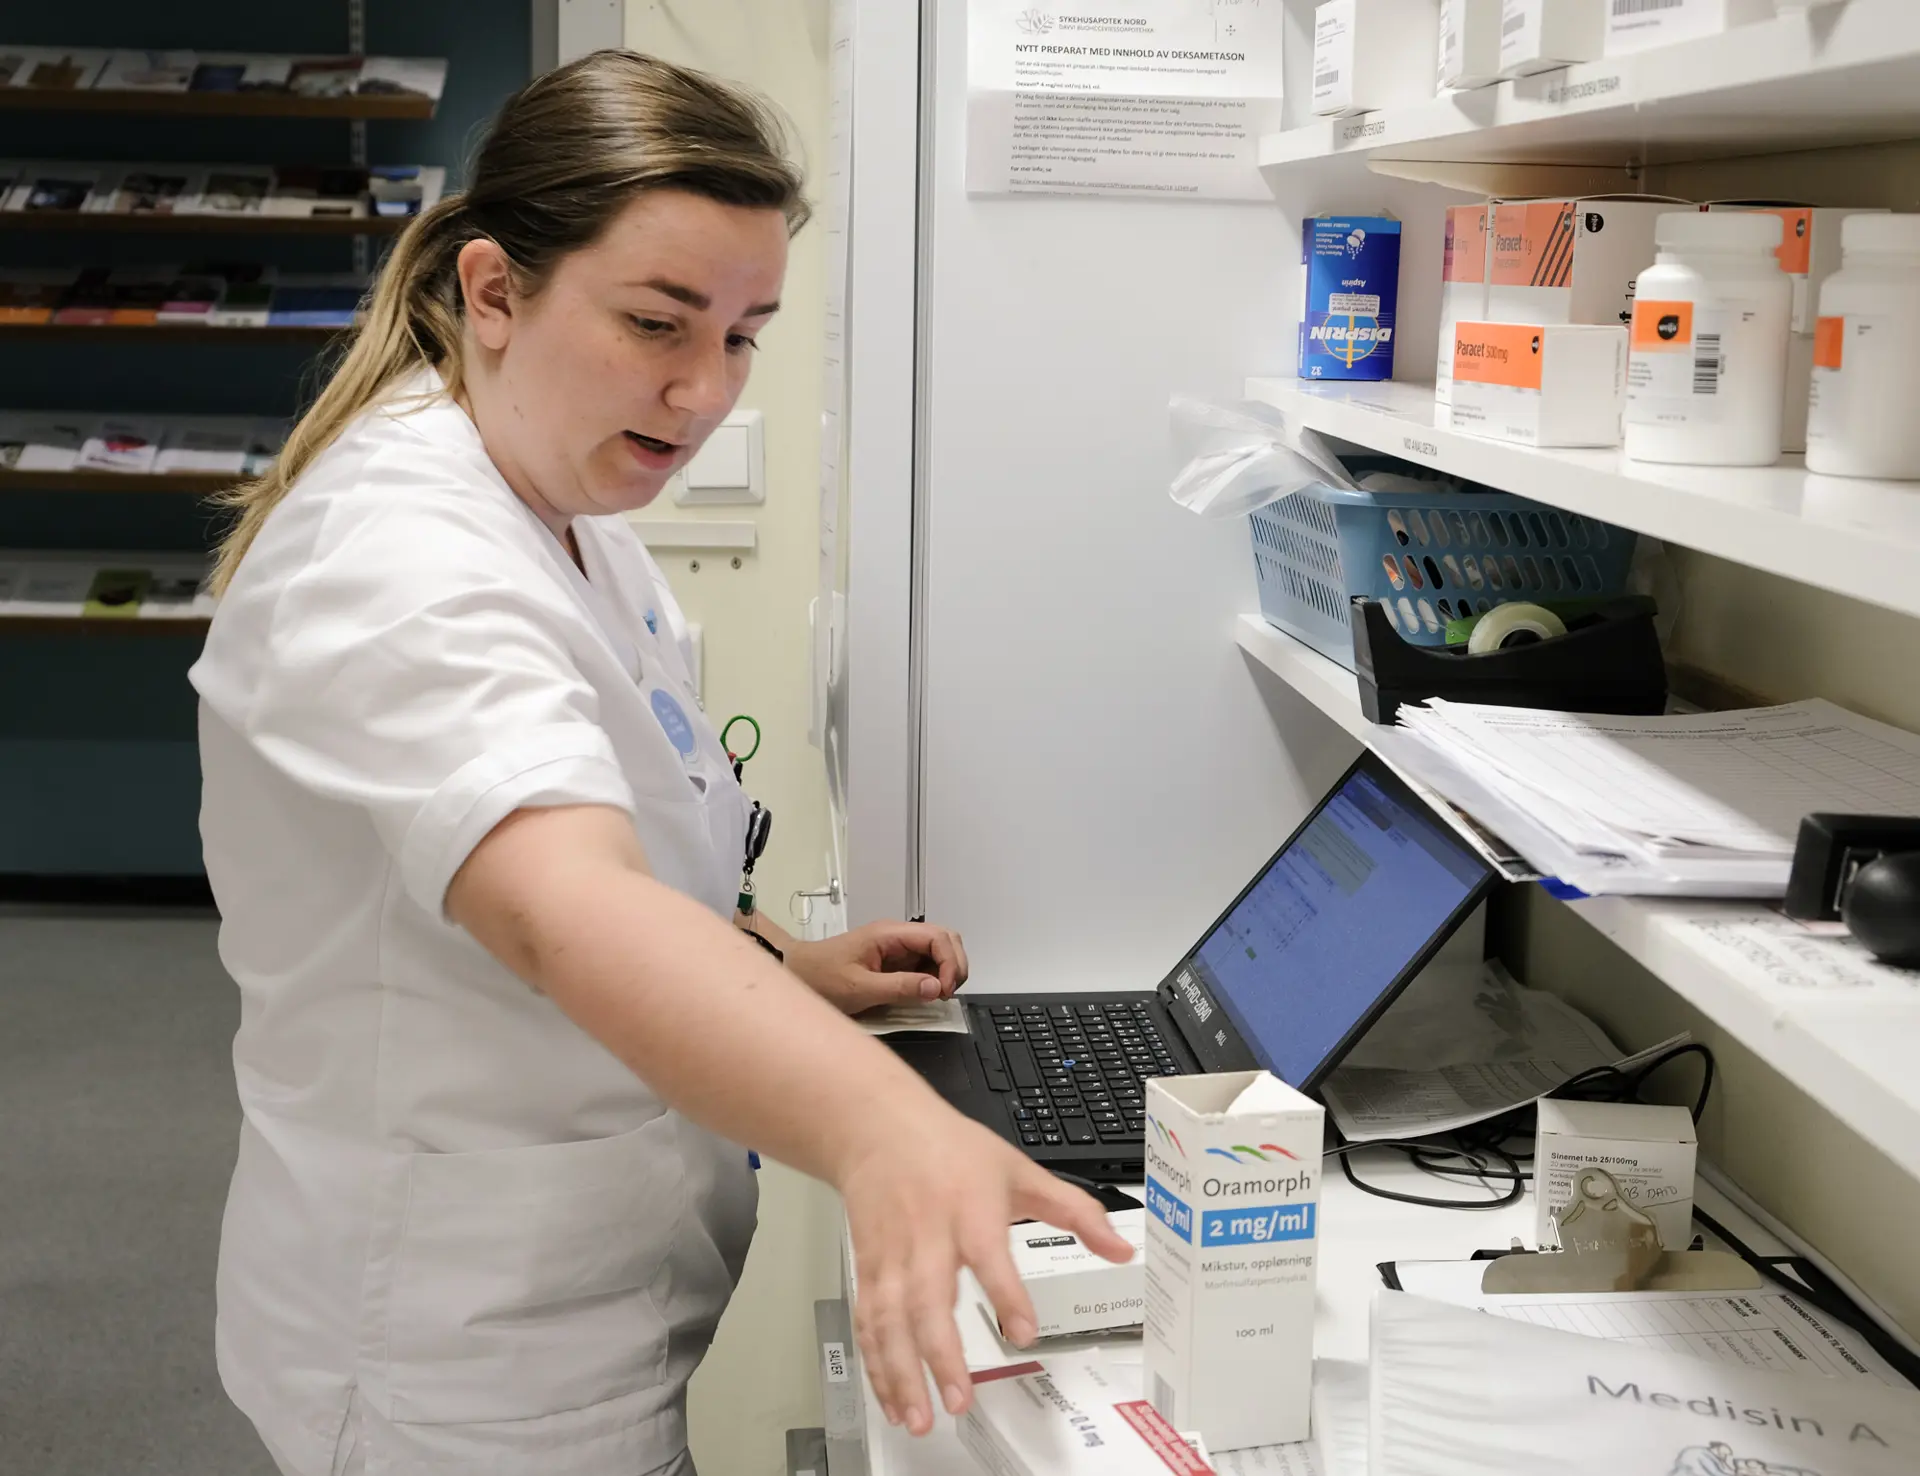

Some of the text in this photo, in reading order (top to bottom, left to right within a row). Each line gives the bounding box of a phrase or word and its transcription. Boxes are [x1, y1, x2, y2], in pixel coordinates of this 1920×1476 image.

[1059, 16, 1147, 26] SYKEHUSAPOTEK NORD
[1016, 44, 1245, 61] NYTT PREPARAT MED INNHOLD AV DEKSAMETASON
[1496, 234, 1532, 255] Paracet 1g
[1342, 280, 1366, 288] Aspirin
[1310, 326, 1392, 342] DISPRIN
[1456, 340, 1508, 364] Paracet 500mg
[1310, 366, 1322, 376] 32
[1215, 1030, 1227, 1047] DELL
[1551, 1152, 1638, 1166] Sinemet tab 25/100mg
[1146, 1144, 1192, 1193] Oramorph
[1149, 1187, 1190, 1232] 2 mg/ml
[1210, 1206, 1308, 1241] 2 mg/ml
[1202, 1254, 1312, 1272] Mikstur, oppløsning
[1074, 1298, 1143, 1314] depot 50 mg
[1236, 1324, 1274, 1338] 100 ml
[1773, 1329, 1808, 1360] MEDIKAMENT
[829, 1349, 843, 1376] SALVER
[1587, 1374, 1890, 1448] Medisin A
[1070, 1416, 1096, 1432] 0,4
[1083, 1432, 1105, 1448] mg
